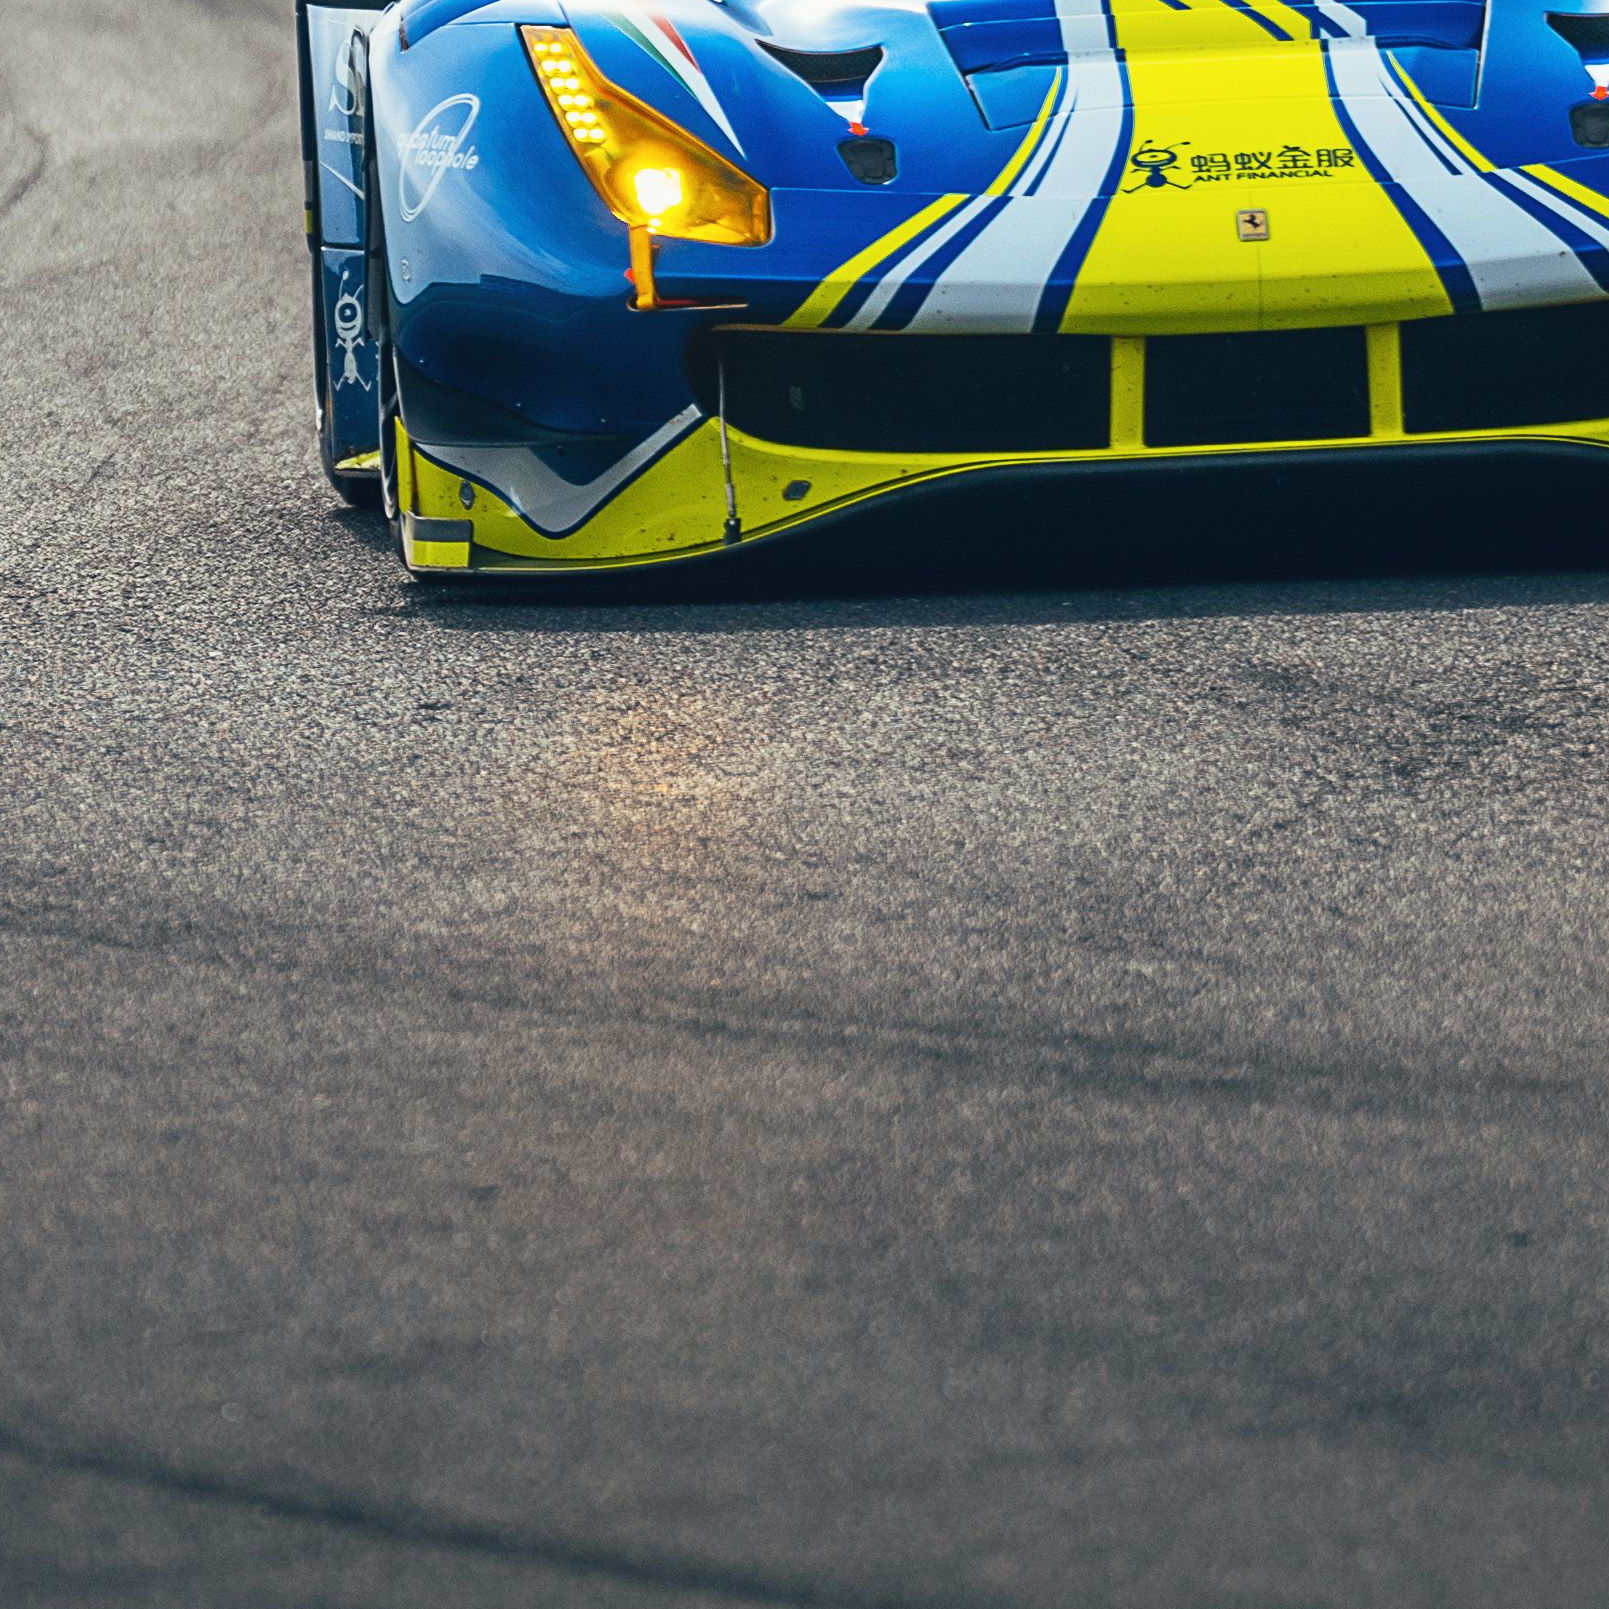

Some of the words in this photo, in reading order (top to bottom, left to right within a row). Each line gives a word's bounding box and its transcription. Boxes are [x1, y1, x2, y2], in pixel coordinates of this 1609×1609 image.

[1190, 144, 1355, 173] 蚂蚁金服
[1194, 173, 1231, 183] ANT
[1236, 170, 1333, 180] FINANCIAL
